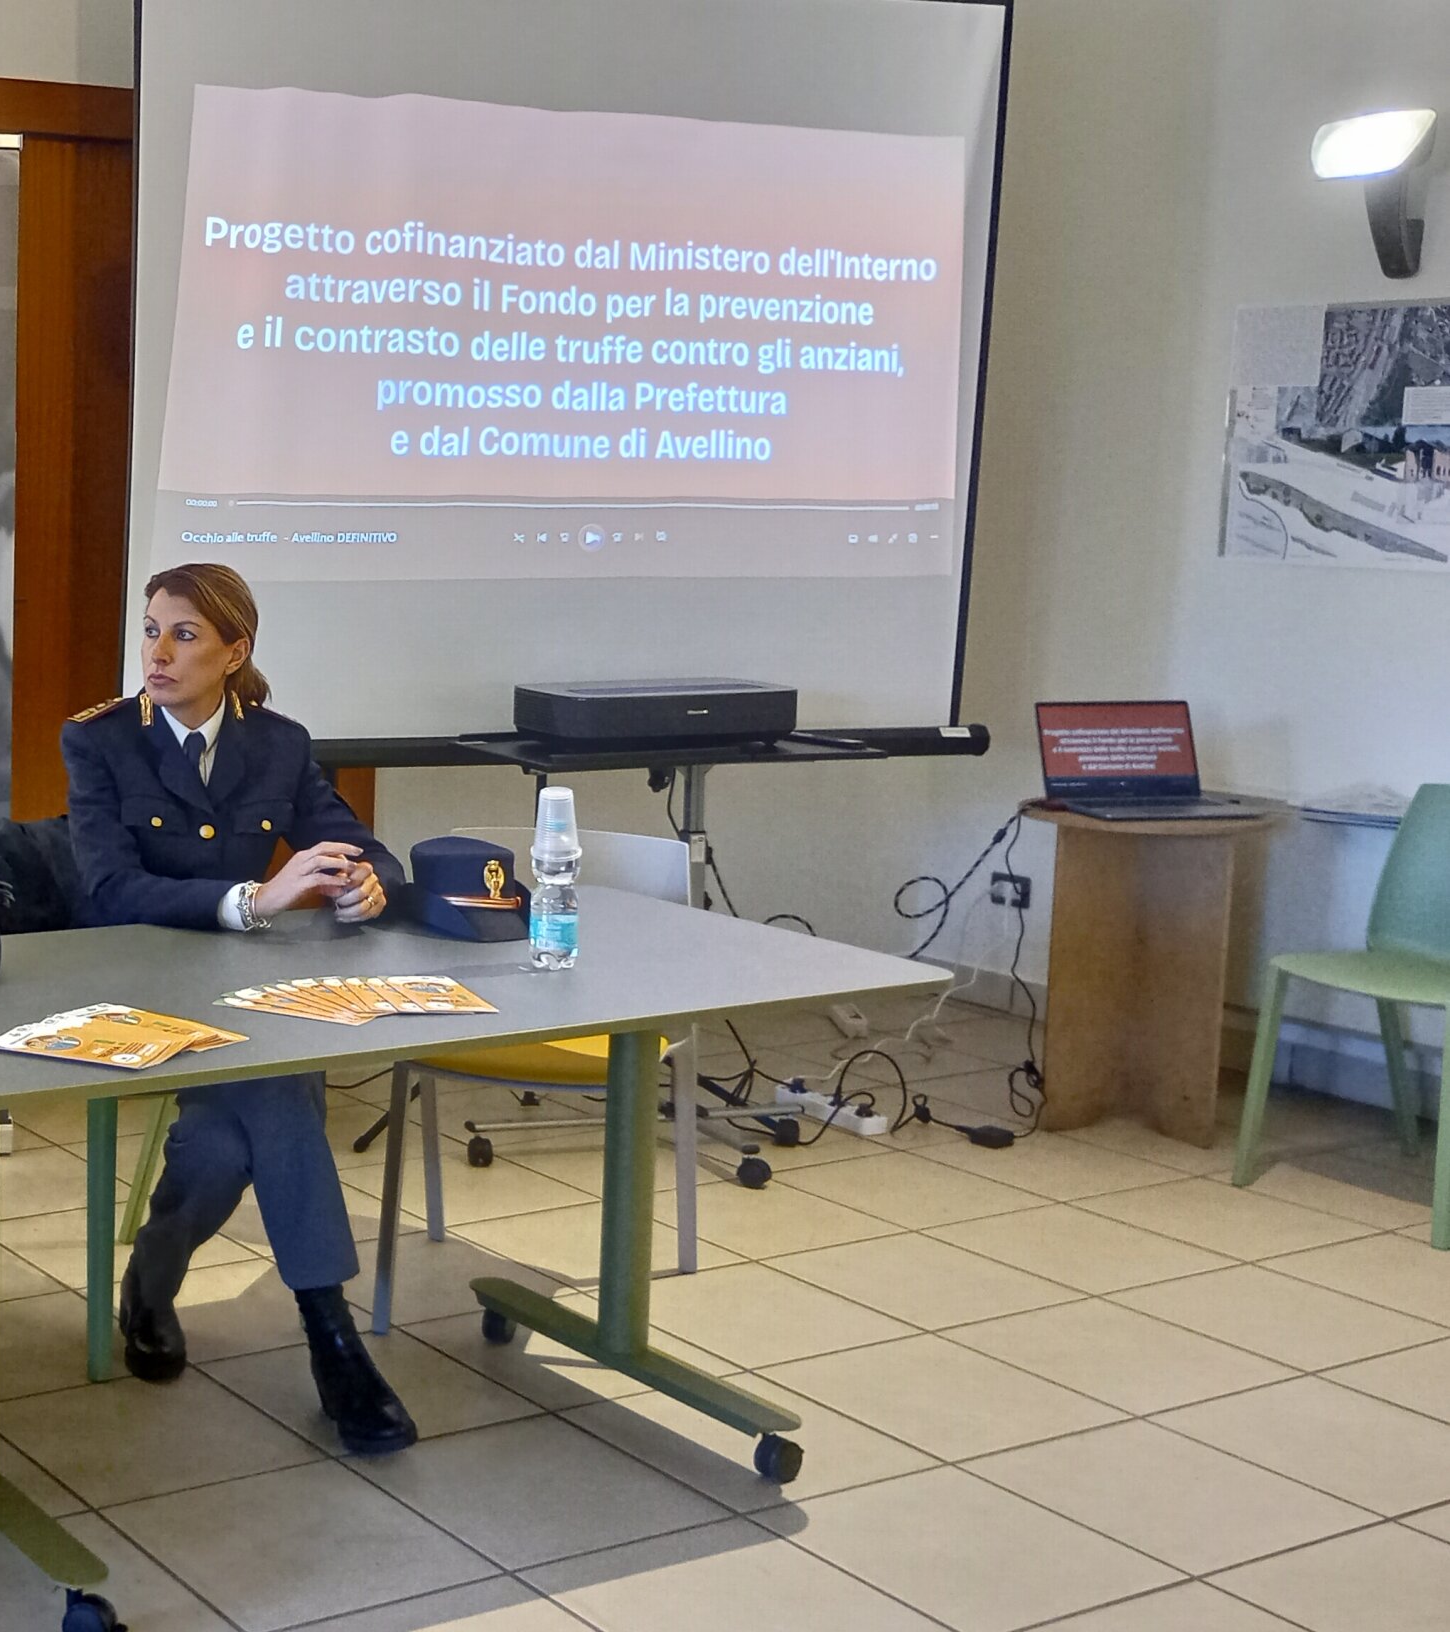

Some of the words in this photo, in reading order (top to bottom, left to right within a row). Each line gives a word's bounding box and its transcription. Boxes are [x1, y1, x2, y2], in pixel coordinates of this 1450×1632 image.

[205, 216, 355, 253] Progetto
[365, 221, 565, 267] cofinanziato
[574, 239, 620, 270] dal
[629, 240, 770, 275] Ministero
[779, 247, 937, 281] dell'Interno
[285, 273, 461, 306] attraverso
[473, 278, 490, 311] il
[501, 284, 596, 316] Fondo
[606, 292, 655, 323] per
[665, 288, 689, 317] la
[700, 294, 873, 326] prevenzione
[237, 322, 254, 349] e
[264, 316, 282, 347] il
[295, 325, 459, 357] contrasto
[471, 331, 545, 362] delle
[556, 335, 643, 364] truffe
[652, 338, 749, 366] contro
[757, 339, 791, 374] gli
[800, 342, 904, 377] anziani,
[377, 379, 541, 410] promosso
[552, 380, 625, 411] dalla
[635, 382, 786, 415] Prefettura
[391, 430, 408, 455] e
[420, 425, 468, 456] dal
[479, 426, 610, 458] Comune
[619, 428, 646, 458] di
[655, 430, 771, 460] Avellino
[181, 531, 224, 543] Occhio
[226, 531, 243, 542] alle
[247, 531, 277, 542] truffe
[291, 532, 334, 543] Avellino
[337, 532, 397, 543] DEFINITIVO
